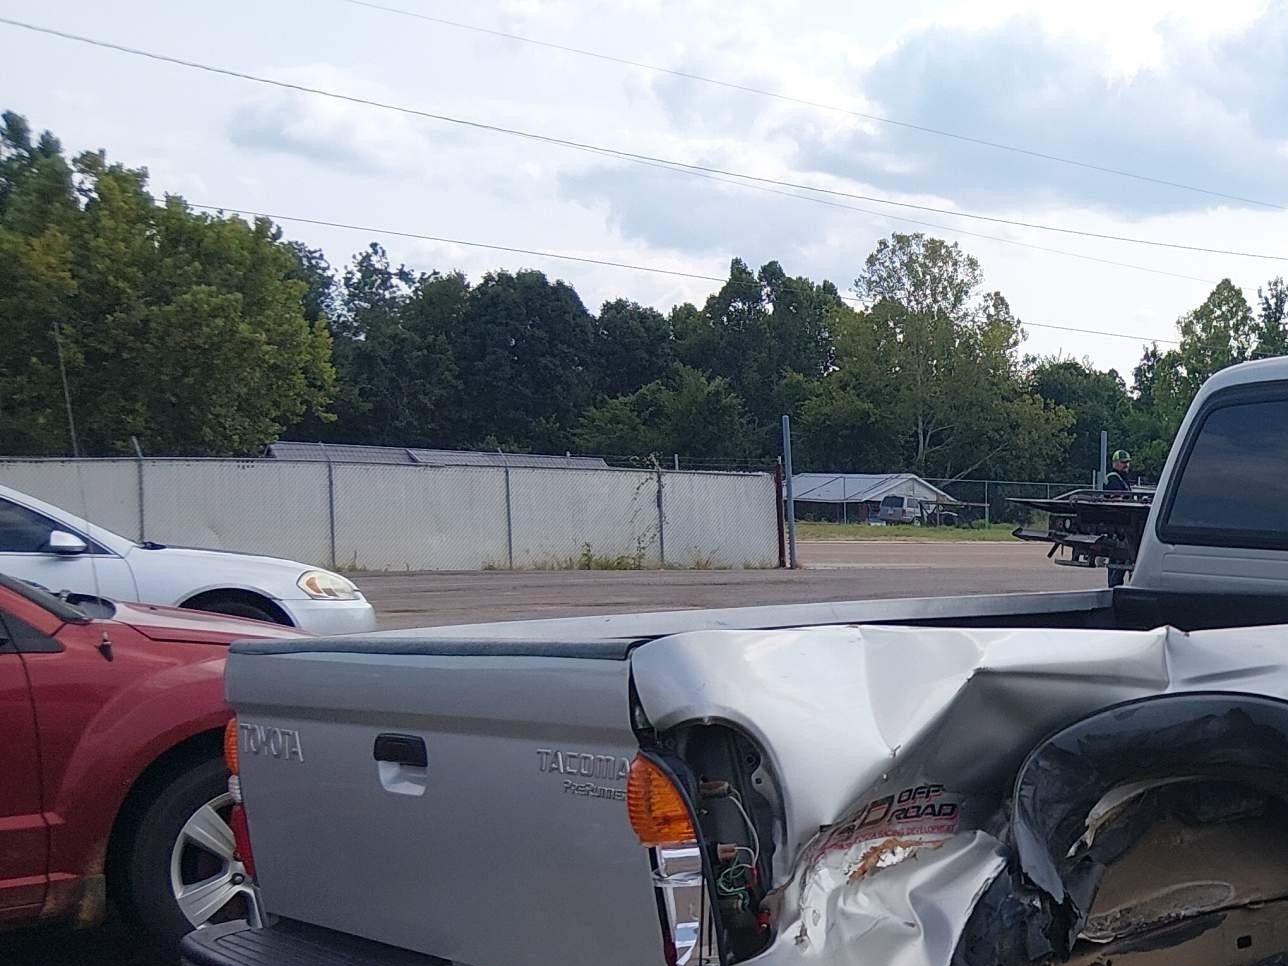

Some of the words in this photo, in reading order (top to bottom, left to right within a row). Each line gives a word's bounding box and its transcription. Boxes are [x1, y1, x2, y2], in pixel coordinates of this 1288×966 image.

[239, 723, 304, 763] TOYOTA
[536, 748, 630, 780] TACOMA
[897, 784, 945, 806] OFF
[888, 803, 959, 824] ROAD
